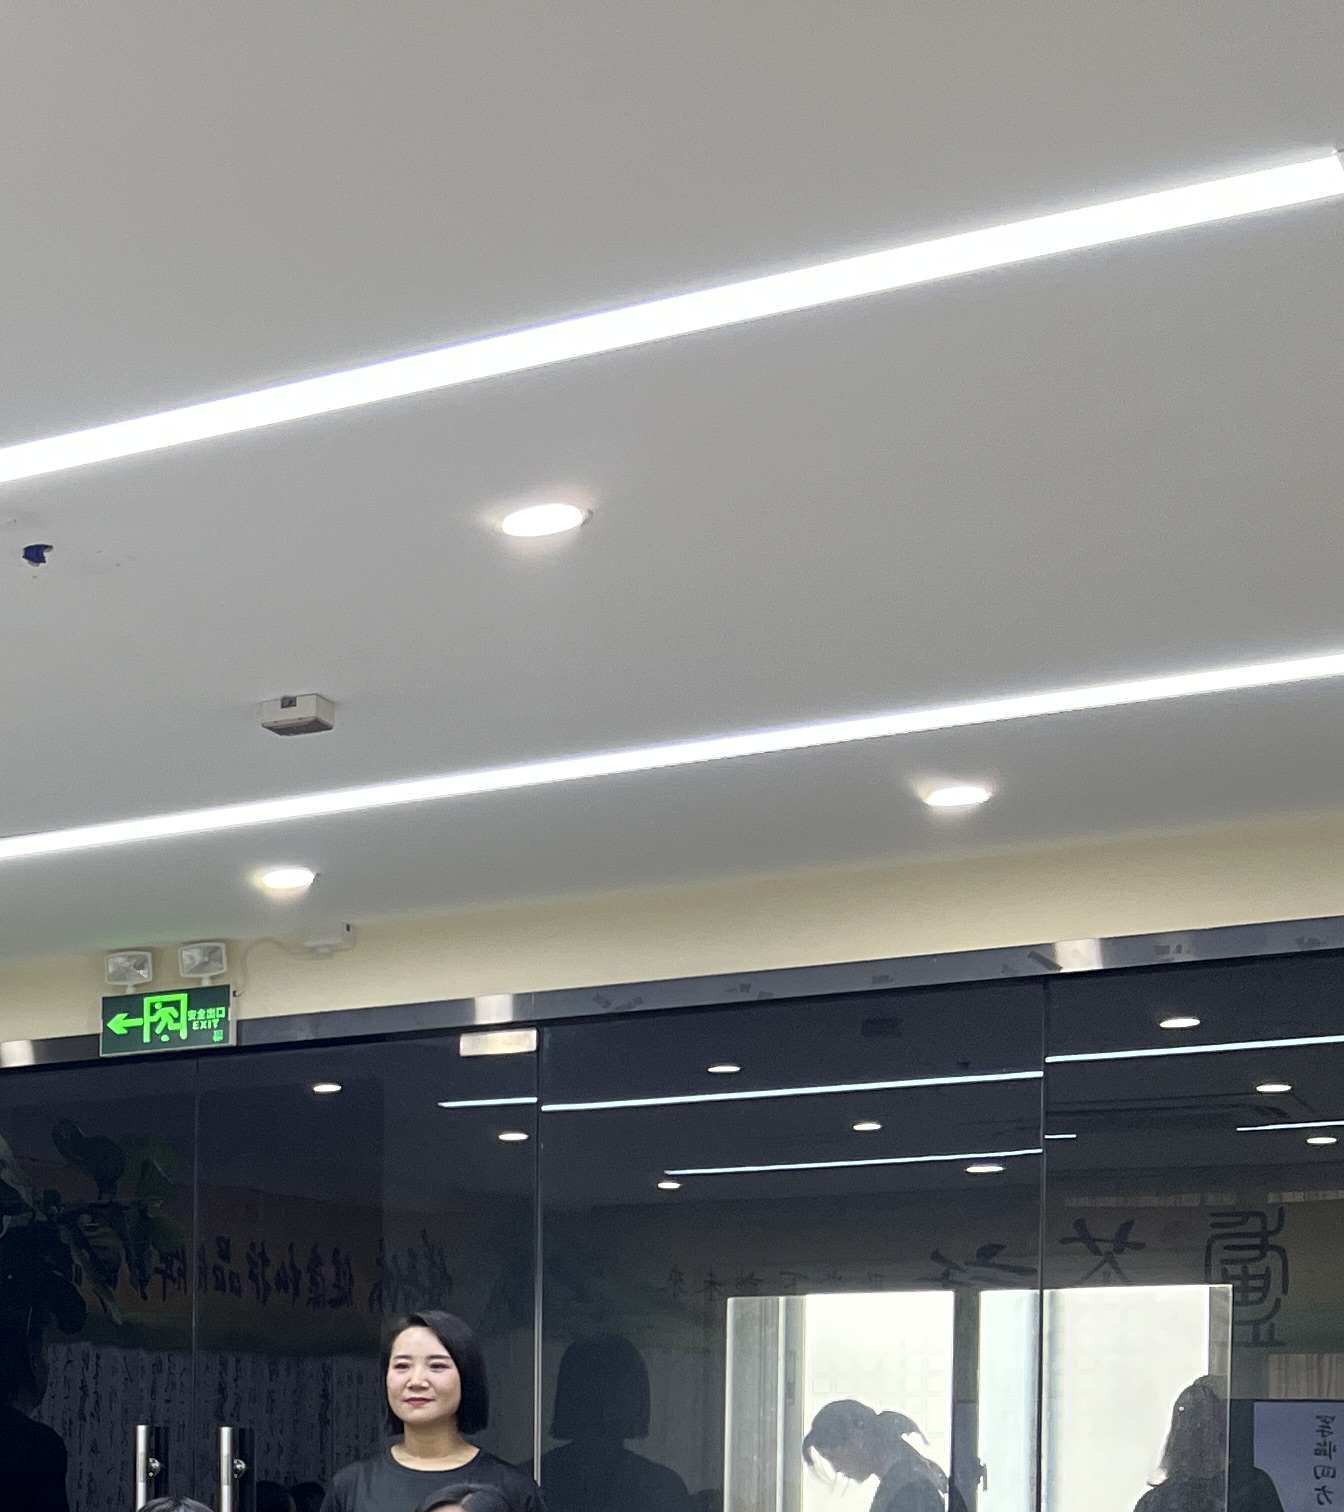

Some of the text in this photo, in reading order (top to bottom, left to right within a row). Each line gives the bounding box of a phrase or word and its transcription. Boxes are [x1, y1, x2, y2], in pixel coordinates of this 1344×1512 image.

[188, 1007, 226, 1022] 安全出口
[192, 1019, 220, 1031] EXIT
